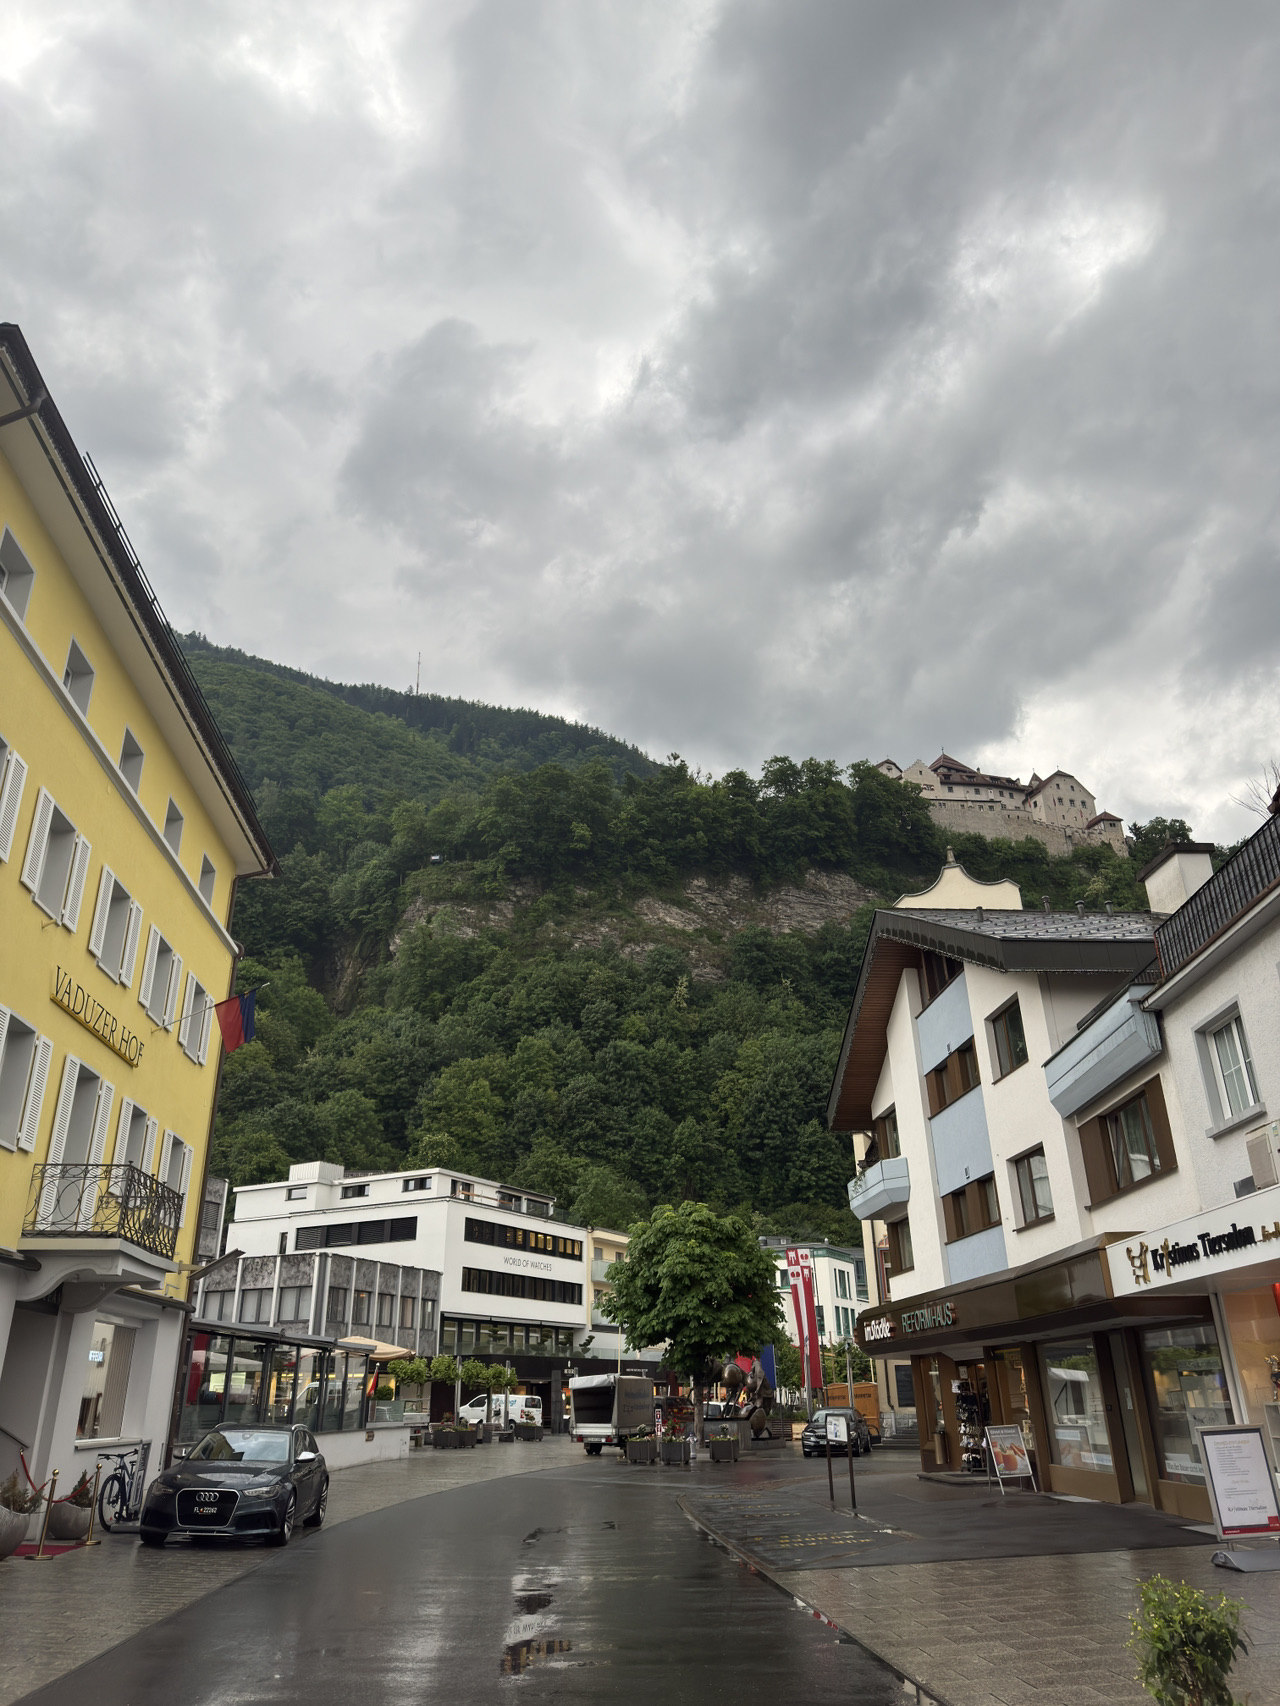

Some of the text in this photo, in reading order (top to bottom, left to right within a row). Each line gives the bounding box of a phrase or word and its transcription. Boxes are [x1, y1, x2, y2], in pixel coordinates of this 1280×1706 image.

[55, 965, 145, 1066] VADUZER HOF
[1197, 1223, 1257, 1258] Tiersalon
[503, 1256, 552, 1272] WORLD OF WATCHES
[901, 1302, 953, 1334] REFORMHAUS
